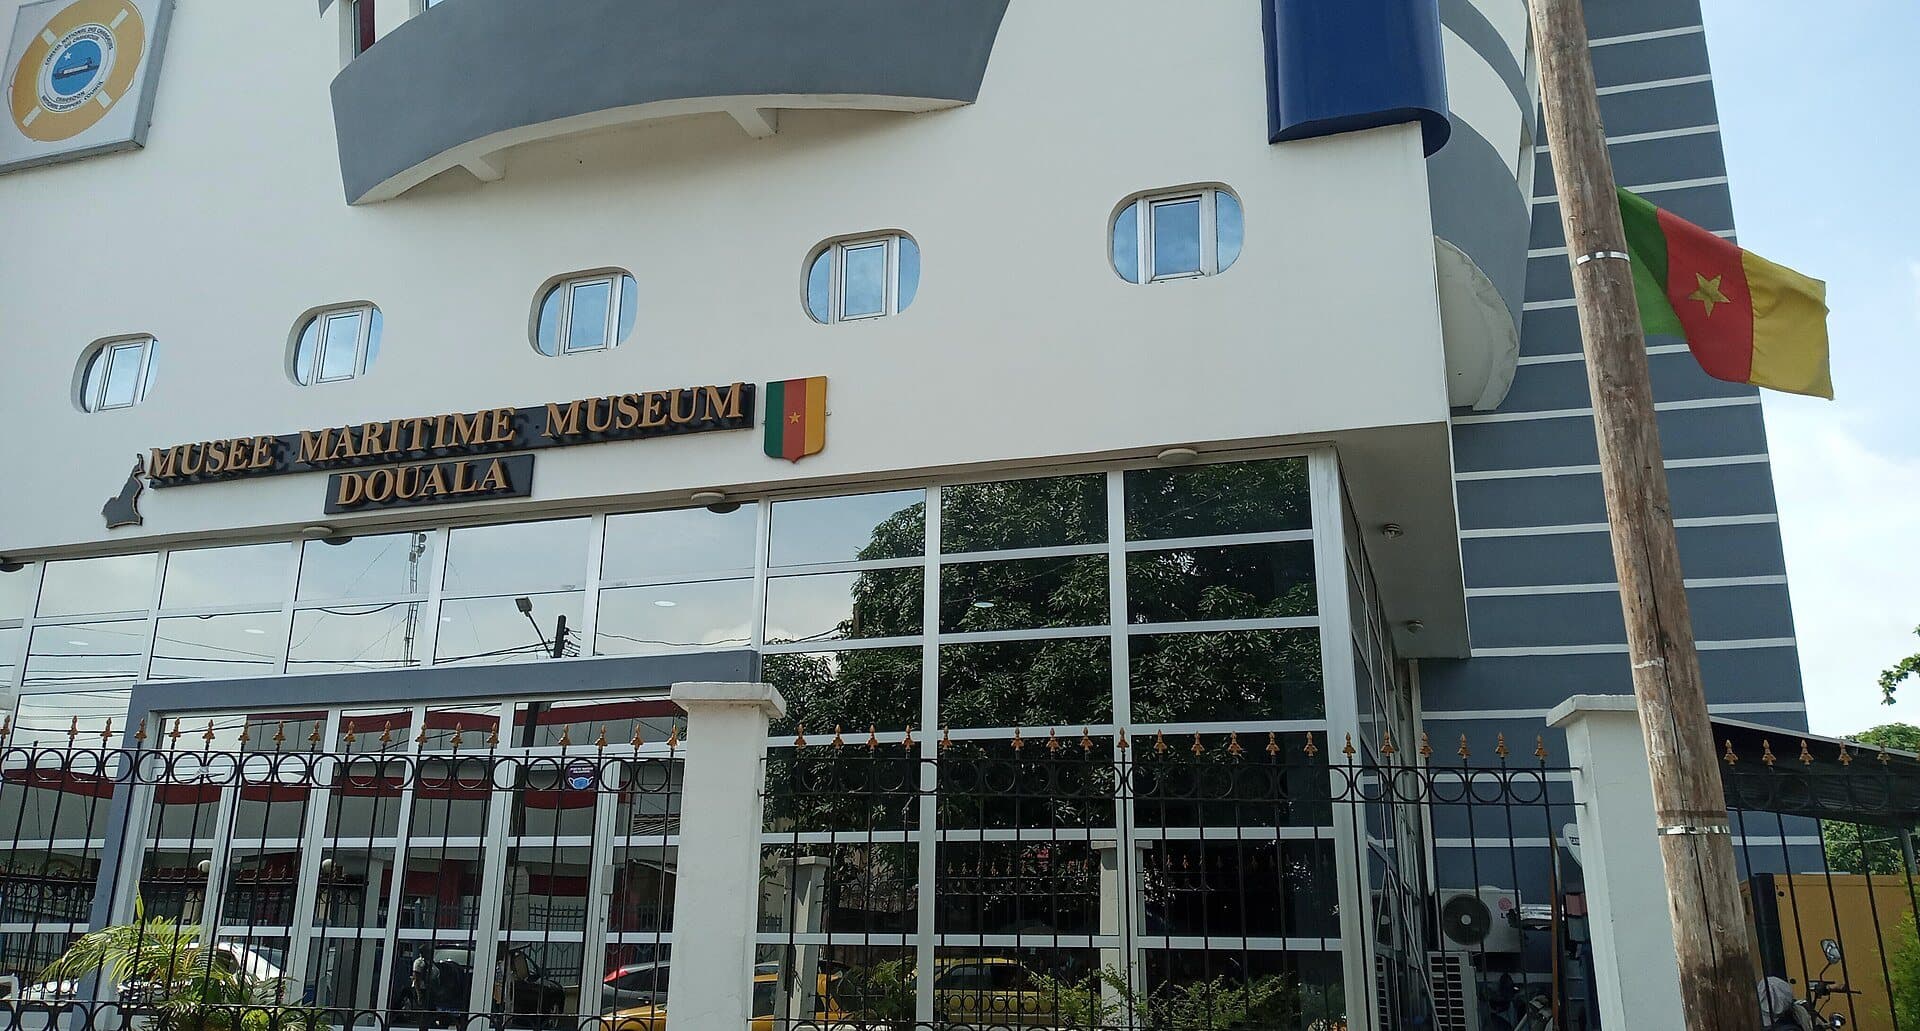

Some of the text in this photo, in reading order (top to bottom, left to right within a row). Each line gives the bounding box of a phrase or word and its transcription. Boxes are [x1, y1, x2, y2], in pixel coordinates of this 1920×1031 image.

[145, 382, 746, 479] MUSEE MARITIME MUSEUM
[334, 457, 512, 506] DOUALA
